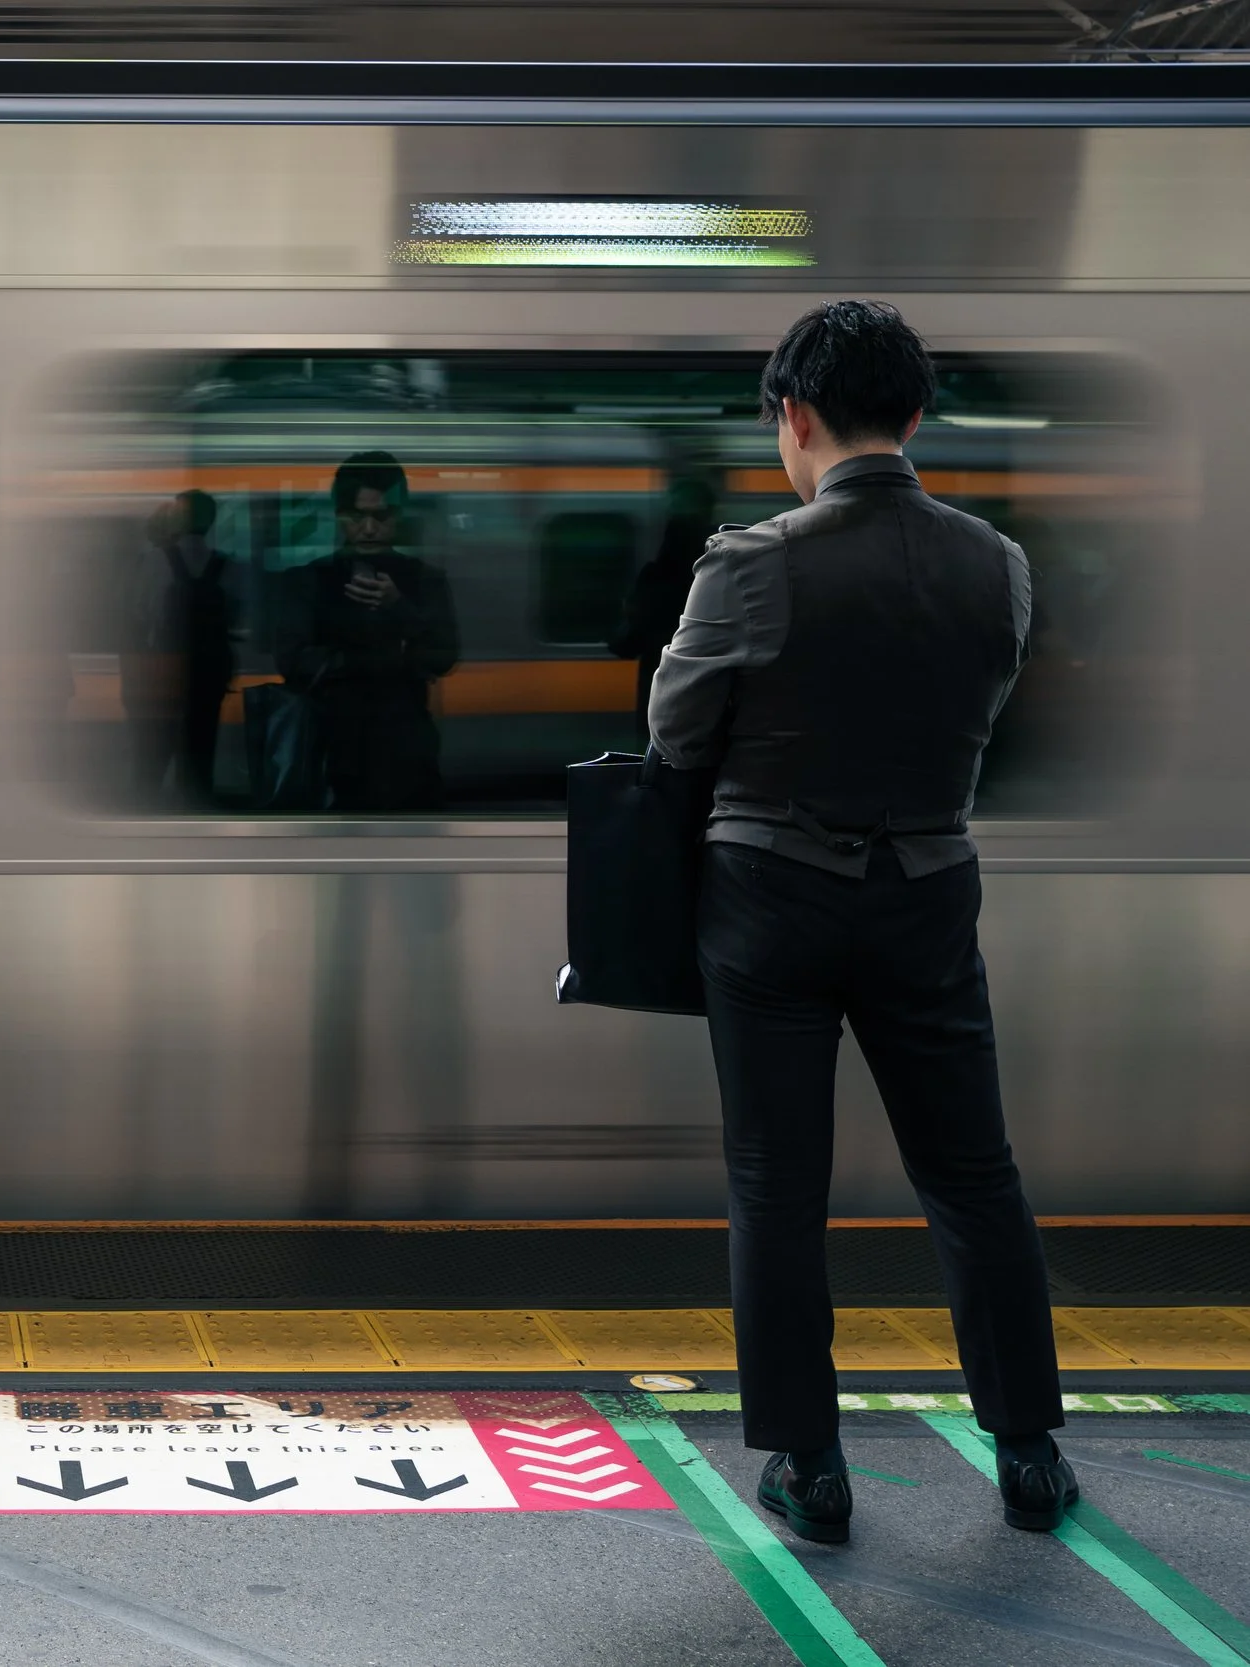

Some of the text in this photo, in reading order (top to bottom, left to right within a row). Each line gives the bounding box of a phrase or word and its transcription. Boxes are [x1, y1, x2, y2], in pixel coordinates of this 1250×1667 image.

[26, 1423, 431, 1434] この場所を空けてください
[30, 1445, 445, 1453] Please leave this area
